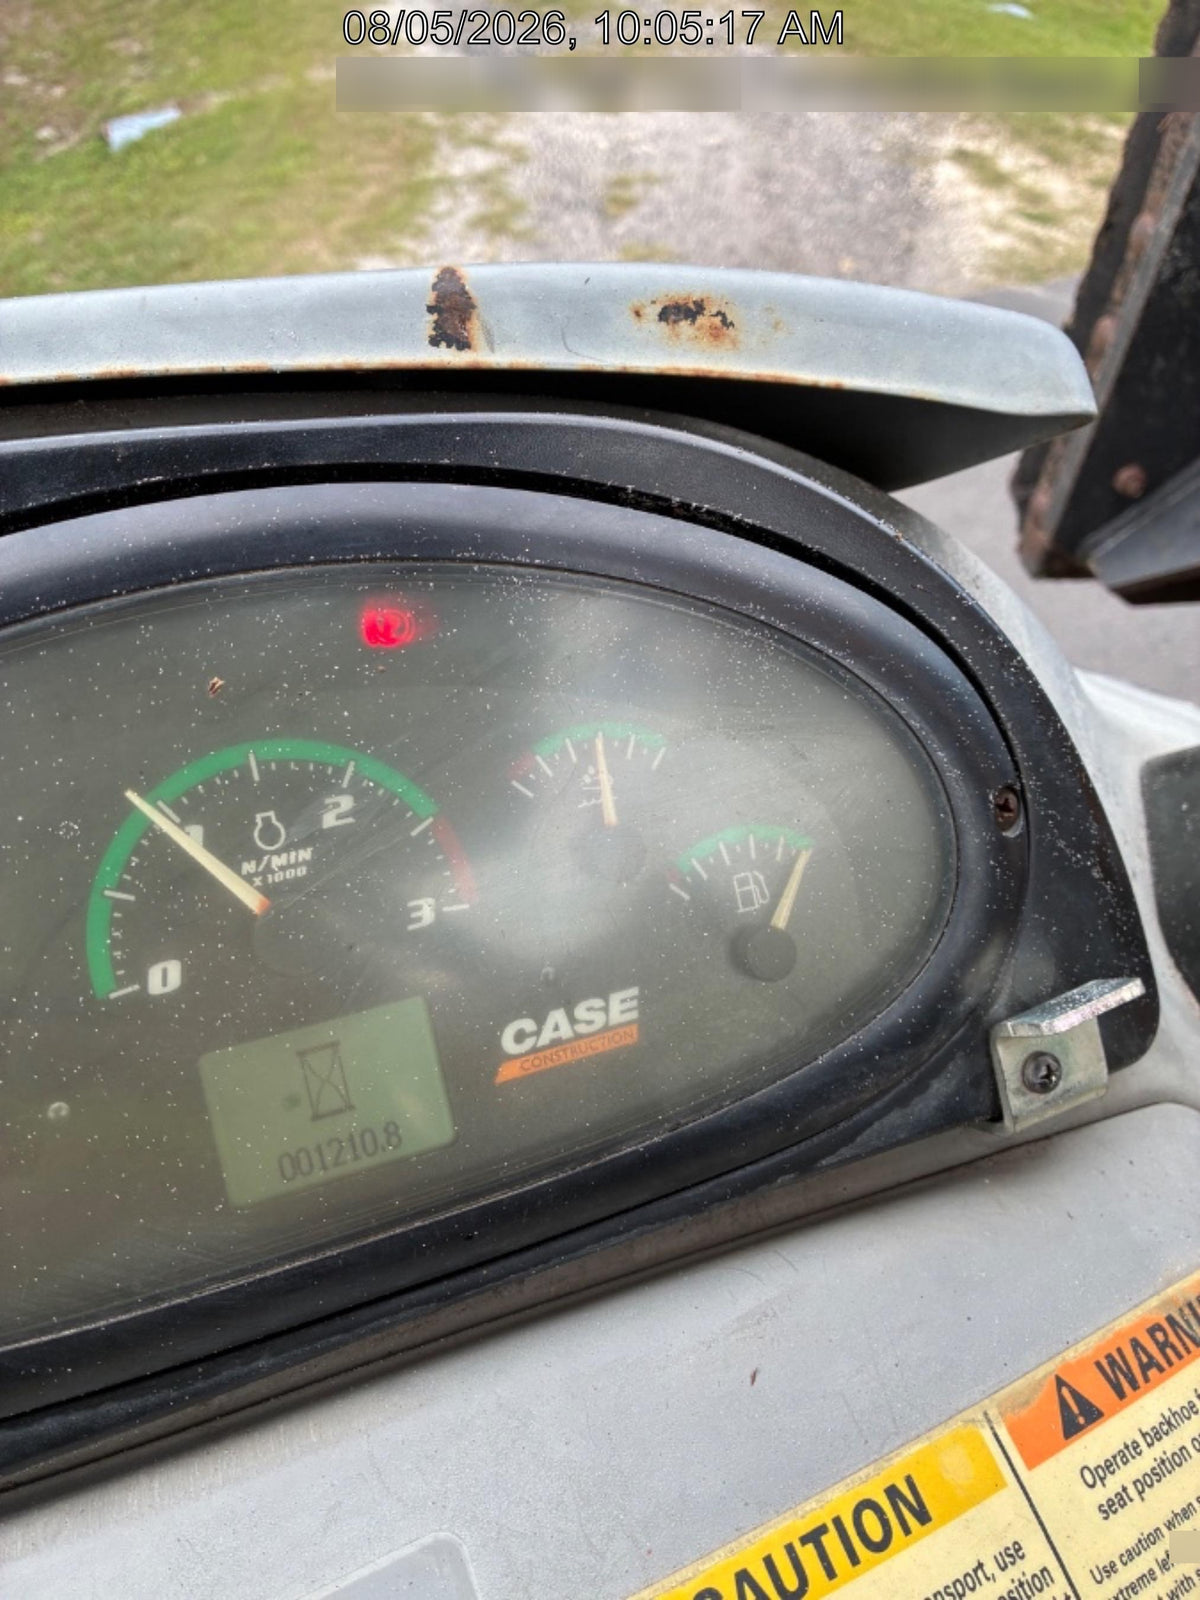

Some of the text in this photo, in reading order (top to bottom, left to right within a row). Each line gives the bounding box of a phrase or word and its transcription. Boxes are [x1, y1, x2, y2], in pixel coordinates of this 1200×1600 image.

[322, 794, 355, 829] 2
[241, 848, 314, 876] N/MIN
[407, 897, 436, 931] 3
[147, 959, 182, 995] 0
[501, 986, 639, 1056] CASE
[519, 1027, 634, 1073] CONSTRUCTION
[278, 1120, 403, 1181] 001210.8
[1080, 1400, 1200, 1489] Operate backhoe
[1098, 1484, 1134, 1521] seat
[1132, 1444, 1192, 1502] position
[1089, 1502, 1197, 1585] Use caution when
[924, 1541, 1025, 1600] nsport, use
[997, 1566, 1055, 1600] sition
[1109, 1567, 1158, 1600] xtreme
[1166, 1573, 1197, 1600] with
